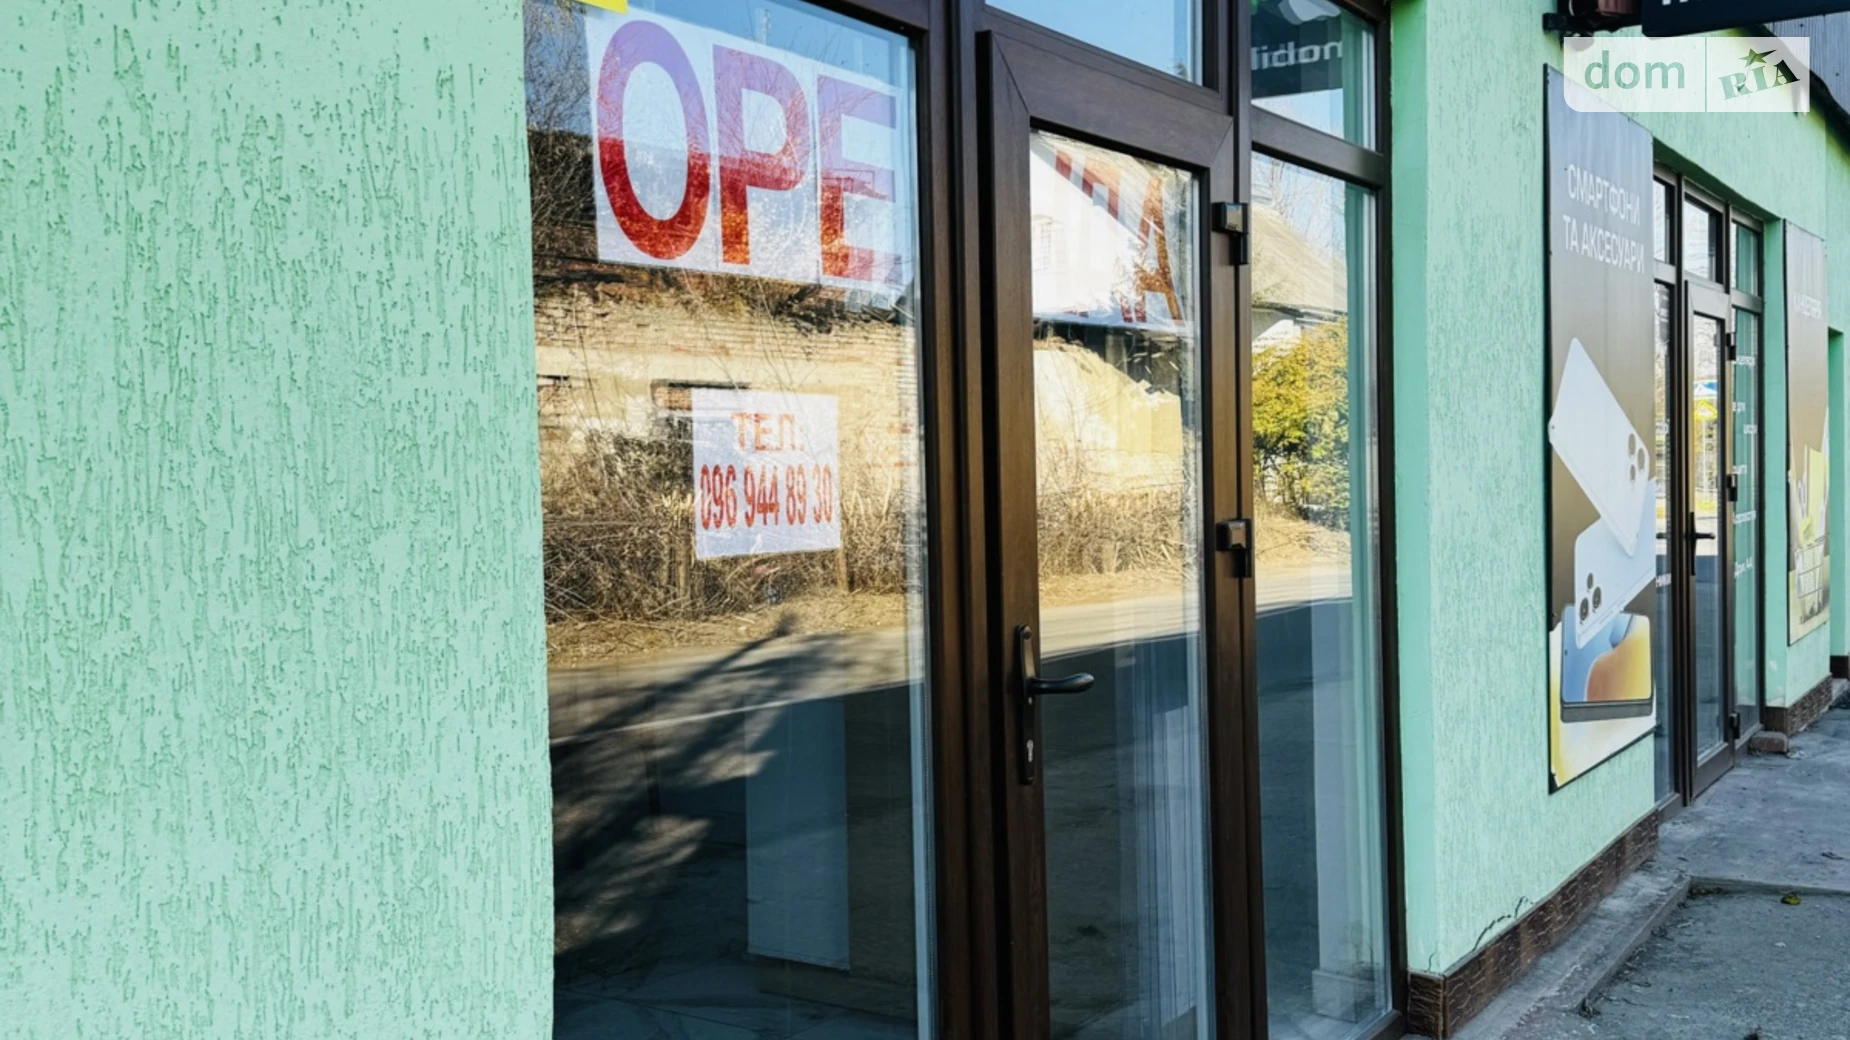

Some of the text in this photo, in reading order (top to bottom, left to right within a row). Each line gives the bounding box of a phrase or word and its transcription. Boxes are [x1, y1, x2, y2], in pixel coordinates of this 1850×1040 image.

[1567, 163, 1641, 226] СМАРТФОНИ
[1562, 213, 1645, 275] ТА АКСЕСУАРИ
[700, 463, 833, 531] 096 944 89 30
